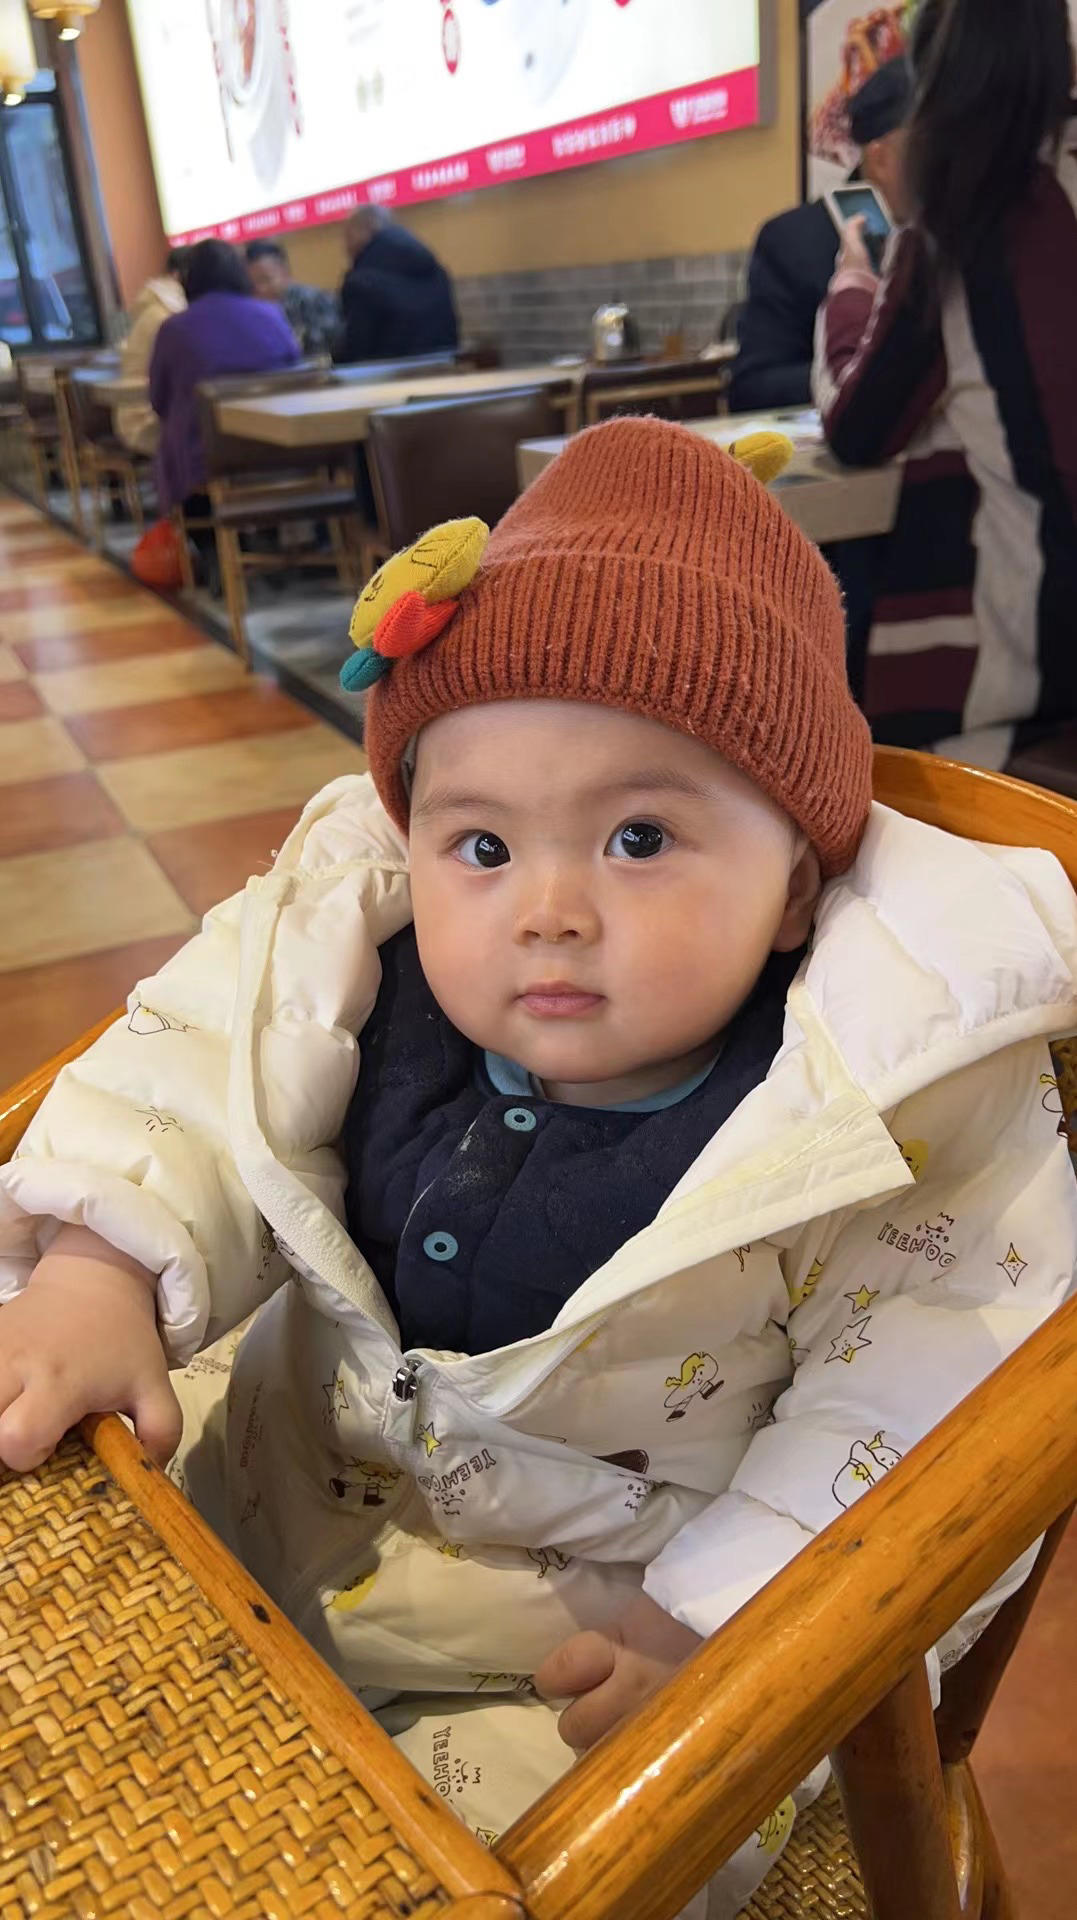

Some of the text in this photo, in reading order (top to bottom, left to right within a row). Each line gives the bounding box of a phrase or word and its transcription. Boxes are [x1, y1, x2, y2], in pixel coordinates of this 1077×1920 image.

[877, 1221, 957, 1268] YEEHOO
[418, 1448, 497, 1492] YEEHOO
[432, 1726, 453, 1798] YEEHO
